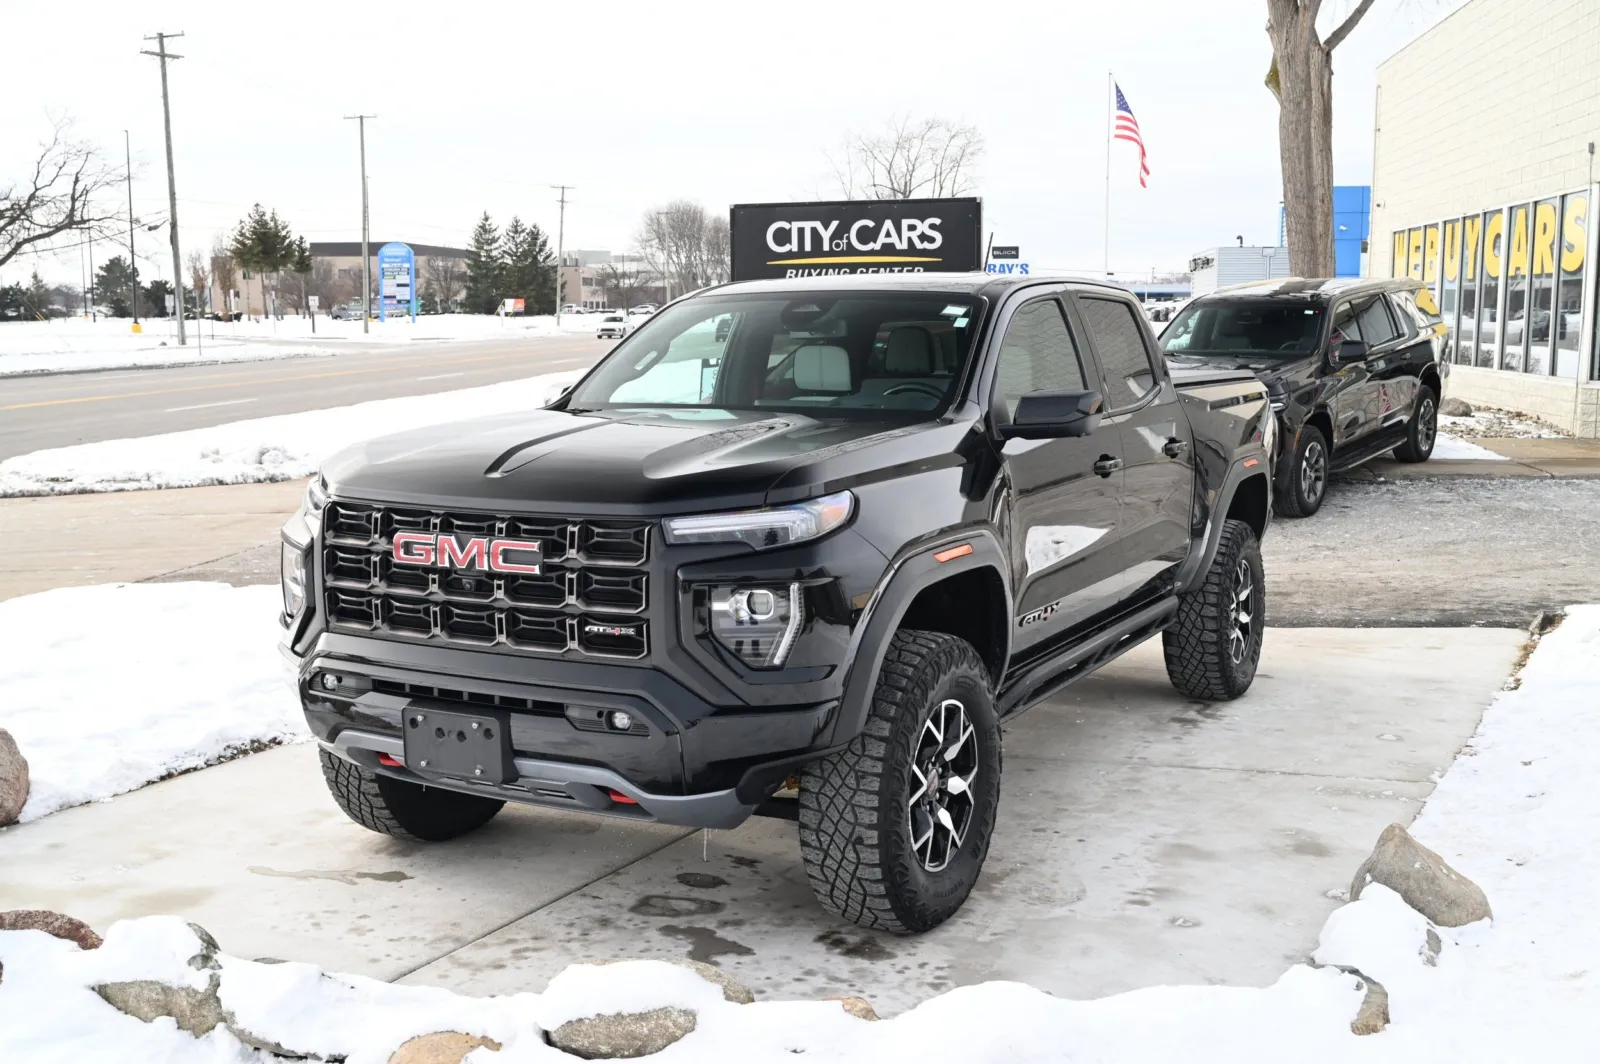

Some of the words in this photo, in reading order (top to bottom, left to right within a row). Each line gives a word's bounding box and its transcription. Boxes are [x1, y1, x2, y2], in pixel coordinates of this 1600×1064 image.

[766, 220, 839, 253] CITY
[832, 233, 848, 251] of
[849, 217, 943, 250] CARS
[1484, 196, 1587, 278] CARS
[393, 530, 541, 575] GMC
[585, 625, 635, 636] AT4X
